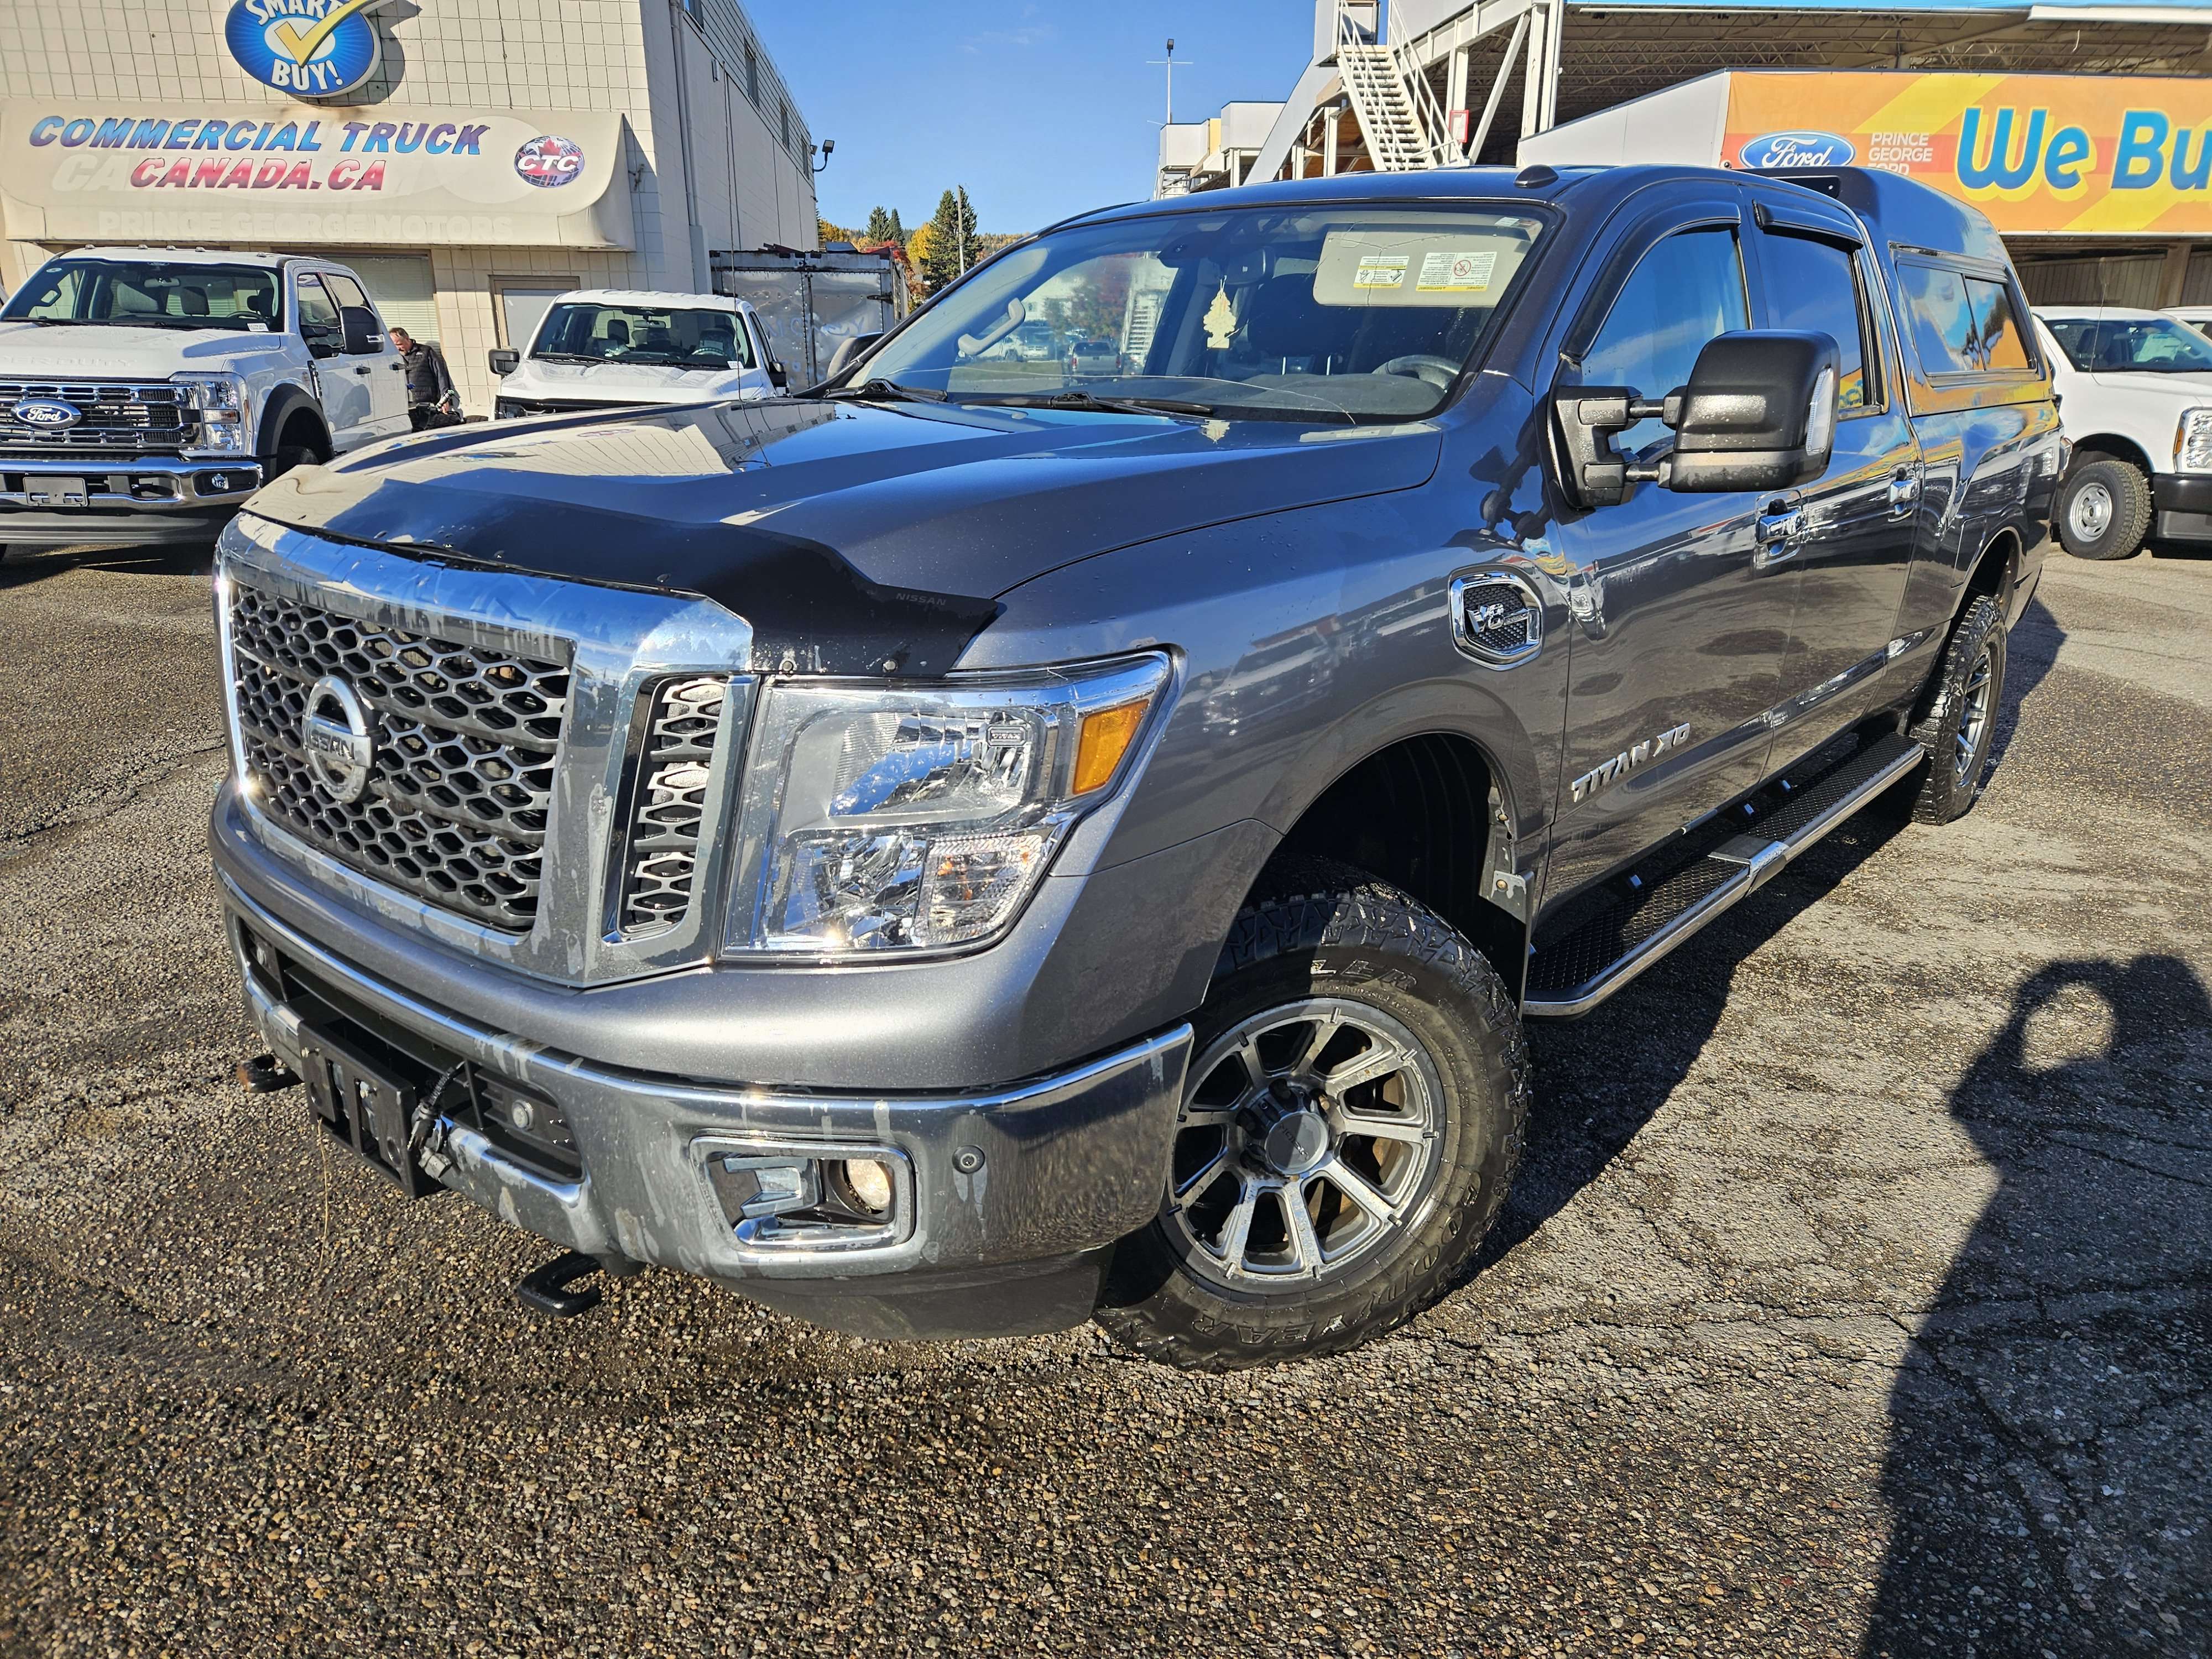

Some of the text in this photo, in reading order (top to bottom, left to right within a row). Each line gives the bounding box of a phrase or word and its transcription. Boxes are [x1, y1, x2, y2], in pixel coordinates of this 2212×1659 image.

[270, 58, 343, 91] BUY!
[29, 115, 491, 155] COMMERCIAL TRUCK
[1871, 132, 1929, 146] PRINCE
[1956, 107, 2212, 191] We Bu
[518, 155, 579, 172] CTC
[1761, 137, 1834, 167] Ford
[1868, 147, 1934, 161] GEORGE
[129, 156, 387, 191] CANADA.CA
[97, 211, 513, 243] PRINCE GEORGE MOTORS
[27, 406, 61, 422] Ford
[895, 592, 947, 606] NISSAN
[1465, 602, 1505, 634] V8
[1571, 721, 1691, 803] TITAN XD
